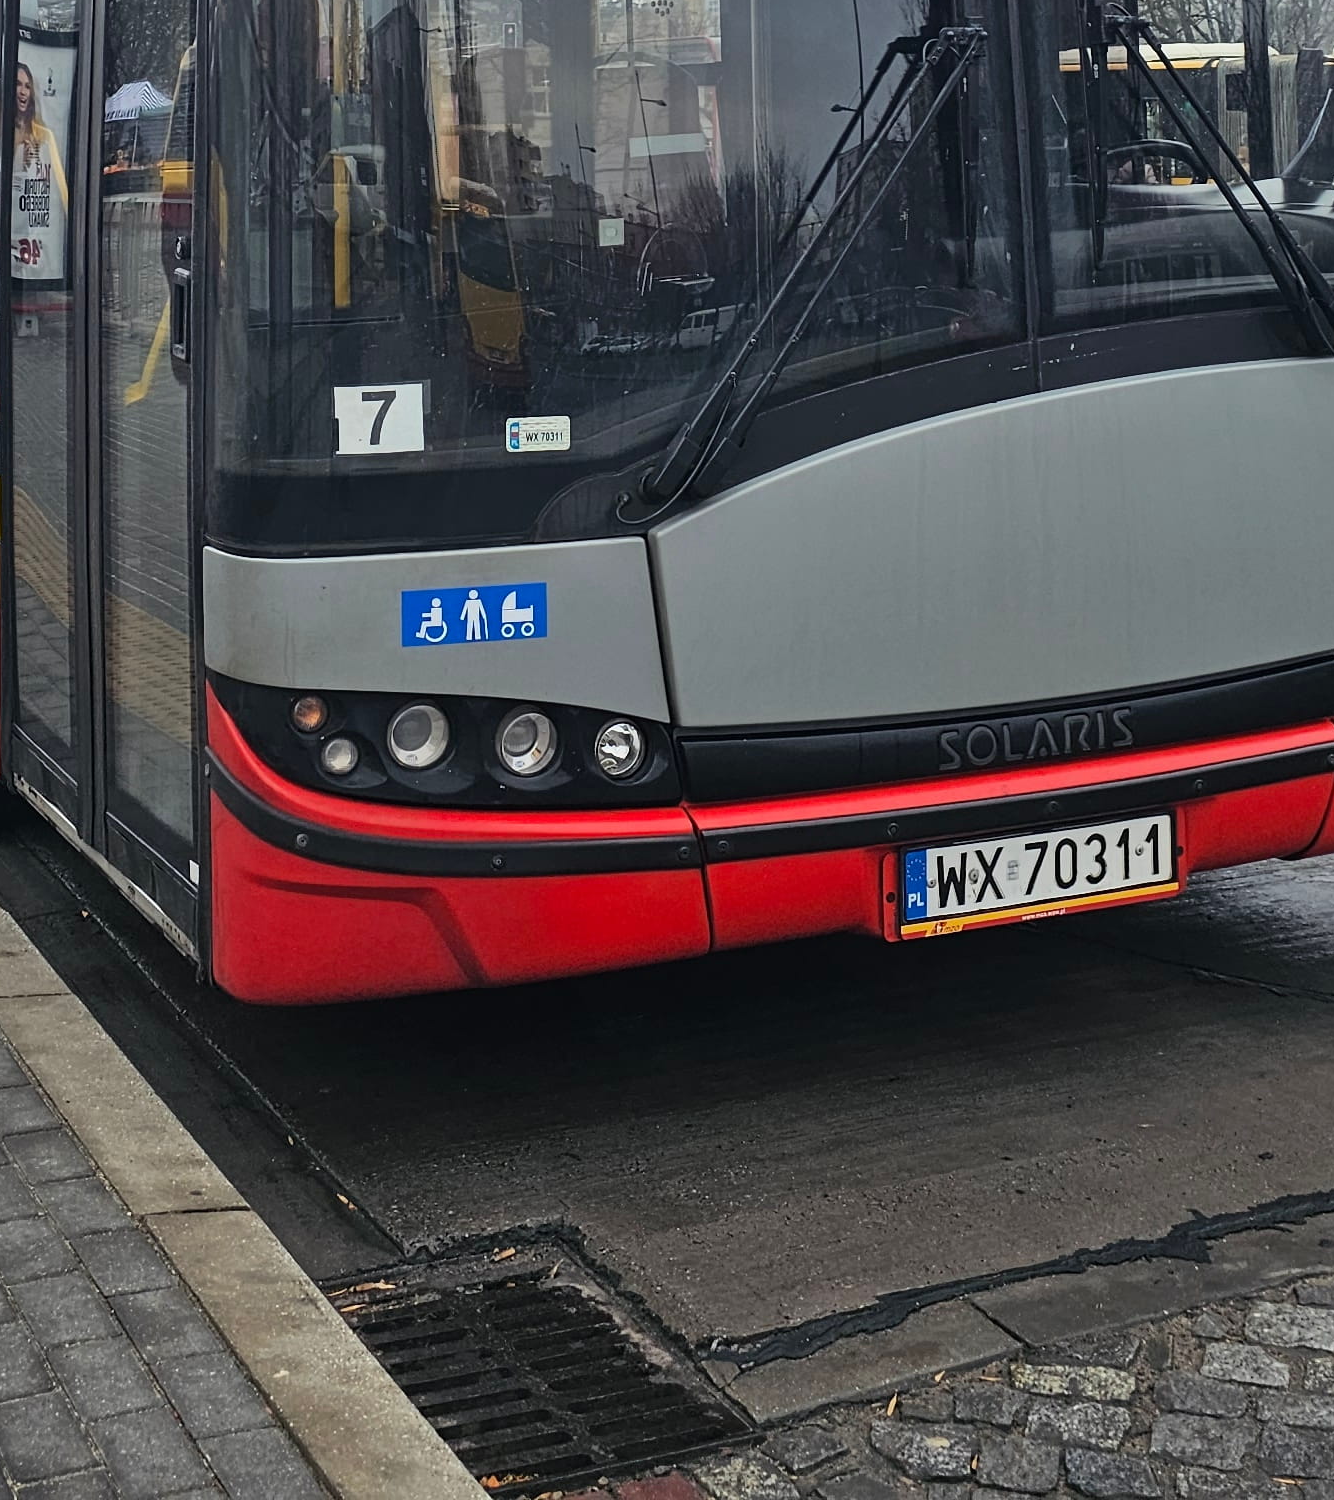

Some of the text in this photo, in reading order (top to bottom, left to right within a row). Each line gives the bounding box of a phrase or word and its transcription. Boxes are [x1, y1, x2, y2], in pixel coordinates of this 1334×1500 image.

[361, 390, 396, 446] 7
[525, 431, 563, 442] WX 70311
[939, 706, 1134, 771] SOLARIS
[936, 823, 1160, 908] WX 70311
[907, 893, 925, 908] PL
